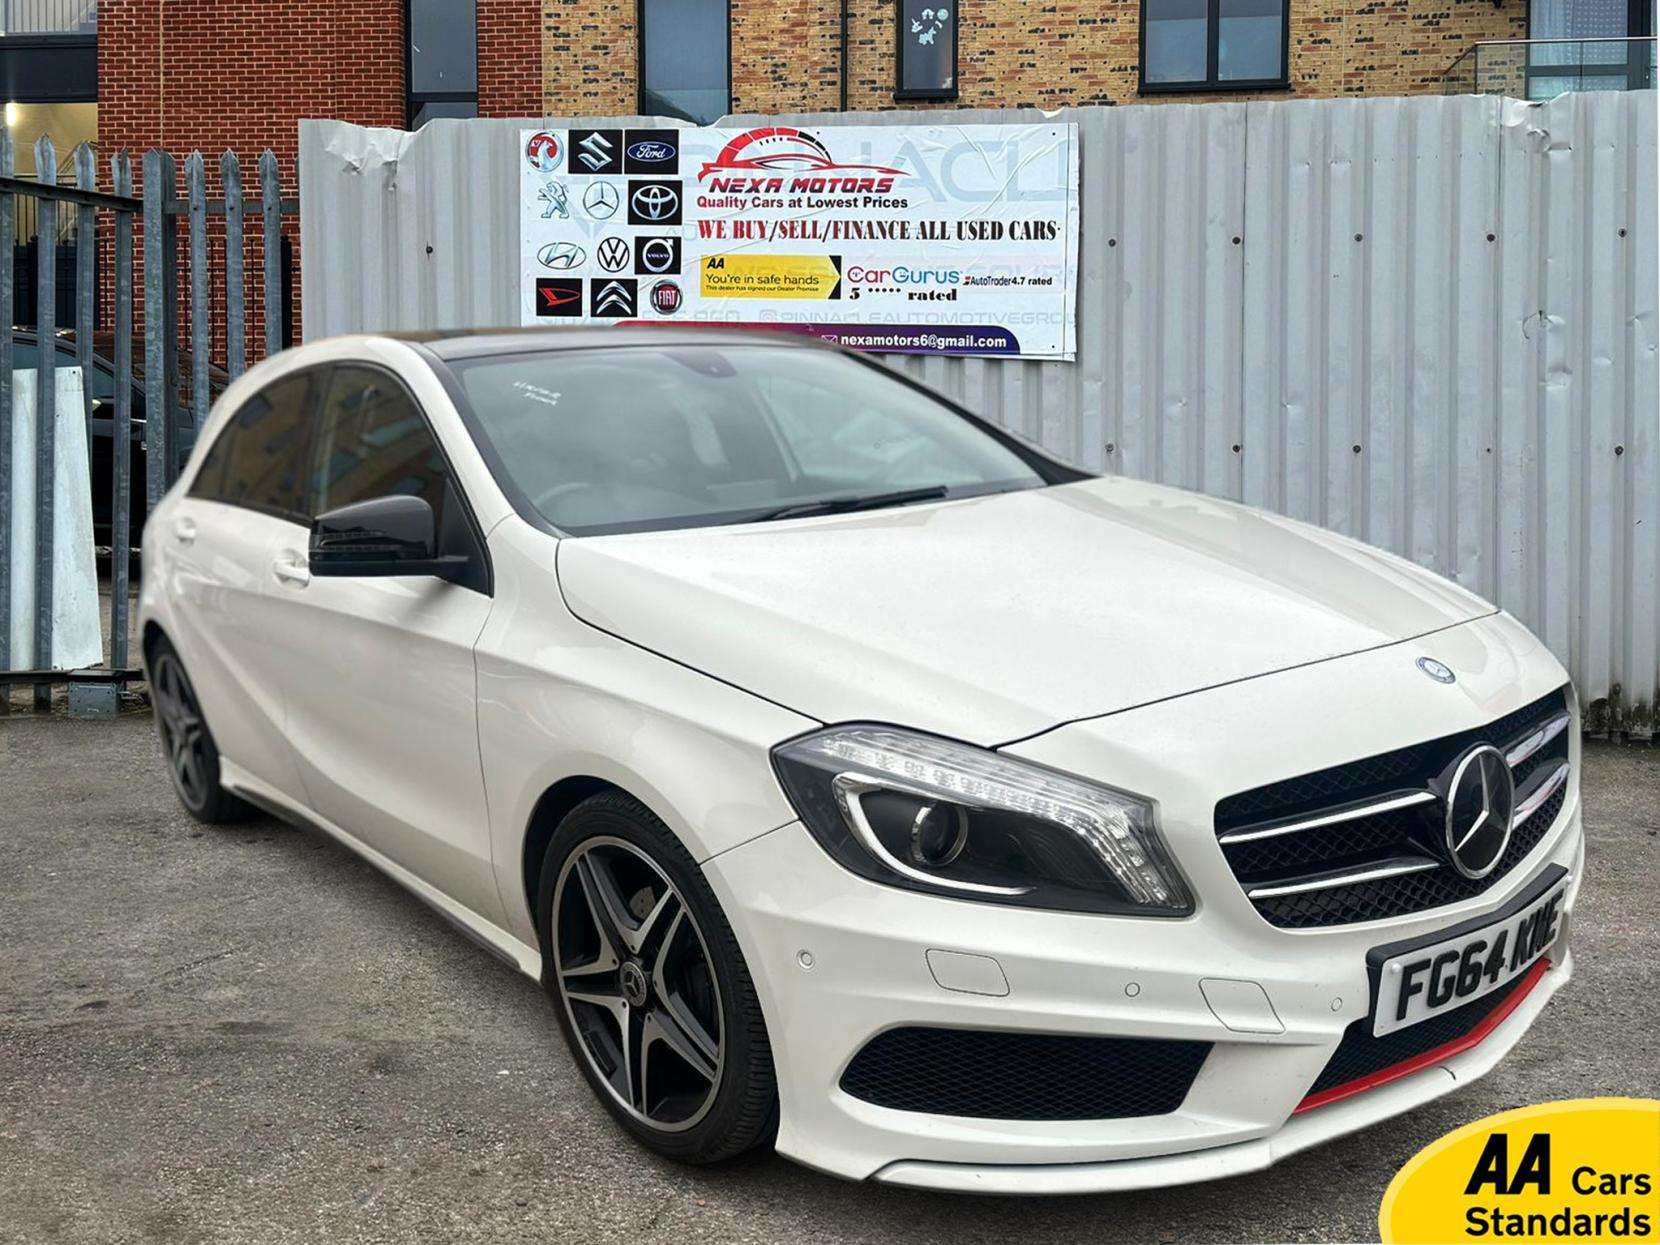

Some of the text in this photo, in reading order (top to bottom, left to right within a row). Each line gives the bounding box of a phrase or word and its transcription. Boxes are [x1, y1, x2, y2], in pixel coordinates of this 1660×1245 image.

[636, 145, 666, 159] Ford
[709, 178, 894, 194] NEXA MOTORS
[697, 196, 908, 211] Quality Cars at Lowest Prices
[697, 220, 727, 239] WE
[916, 220, 950, 240] ALL
[956, 220, 1004, 241] USED
[1009, 220, 1057, 241] CARS
[707, 257, 725, 270] AA
[706, 274, 820, 286] You're in safe hands
[847, 266, 960, 284] CarGurus
[1027, 276, 1053, 286] rated
[658, 290, 676, 305] FIAT
[849, 287, 957, 301] 5 rated
[841, 334, 1007, 349] nexamotors6@gmail.com
[1396, 929, 1509, 1021] FG64
